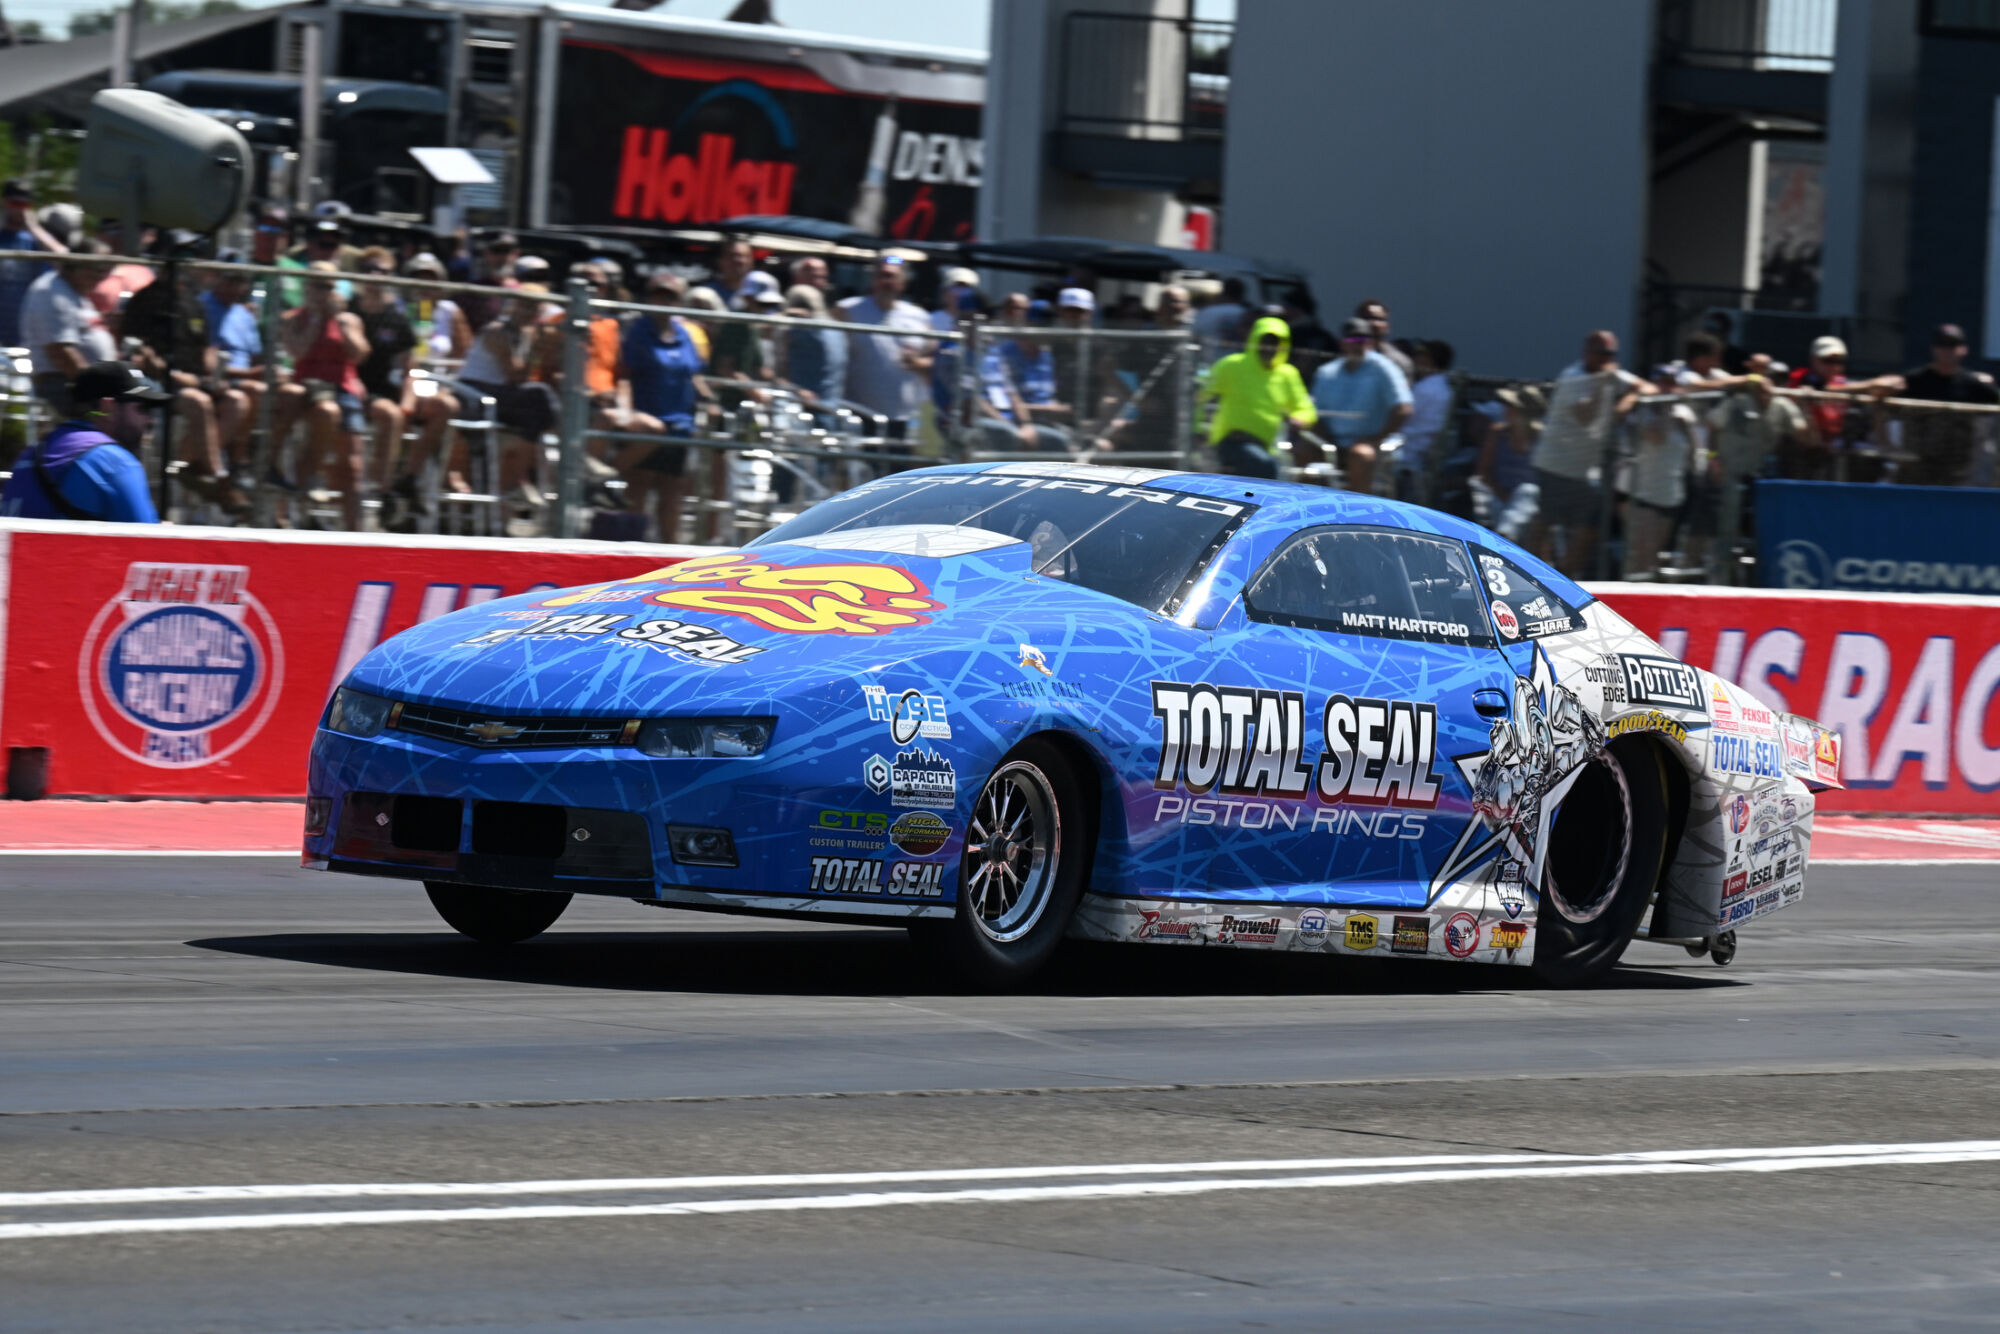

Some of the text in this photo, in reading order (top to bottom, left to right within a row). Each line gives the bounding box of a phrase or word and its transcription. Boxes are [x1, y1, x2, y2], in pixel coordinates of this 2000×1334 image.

[614, 124, 797, 224] Holley
[1487, 569, 1511, 596] 3
[1342, 611, 1470, 638] MATT HARTFORD
[617, 619, 769, 664] SEAL
[1585, 666, 1624, 684] CUTTING
[1623, 656, 1703, 707] ROTTLER
[865, 686, 884, 694] THE
[1602, 686, 1626, 703] EDGE
[868, 694, 947, 722] HOSE
[1742, 707, 1771, 725] PENSKE
[1152, 682, 1443, 809] TOTAL SEAL
[1713, 734, 1751, 774] TOTAL
[1754, 740, 1782, 778] SEAL
[893, 770, 955, 785] CAPACITY
[819, 810, 888, 828] CTS
[907, 818, 940, 826] HIGH
[1154, 796, 1428, 840] PISTON RINGS
[893, 826, 950, 836] PERFORMANCE
[809, 837, 885, 850] CUSTOM TRAILERS
[810, 857, 944, 897] TOTAL SEAL
[1746, 865, 1773, 889] JESEL
[1729, 898, 1754, 922] ABRO
[1221, 915, 1281, 935] Browell
[1350, 920, 1374, 938] TMS
[1490, 926, 1527, 950] INDY
